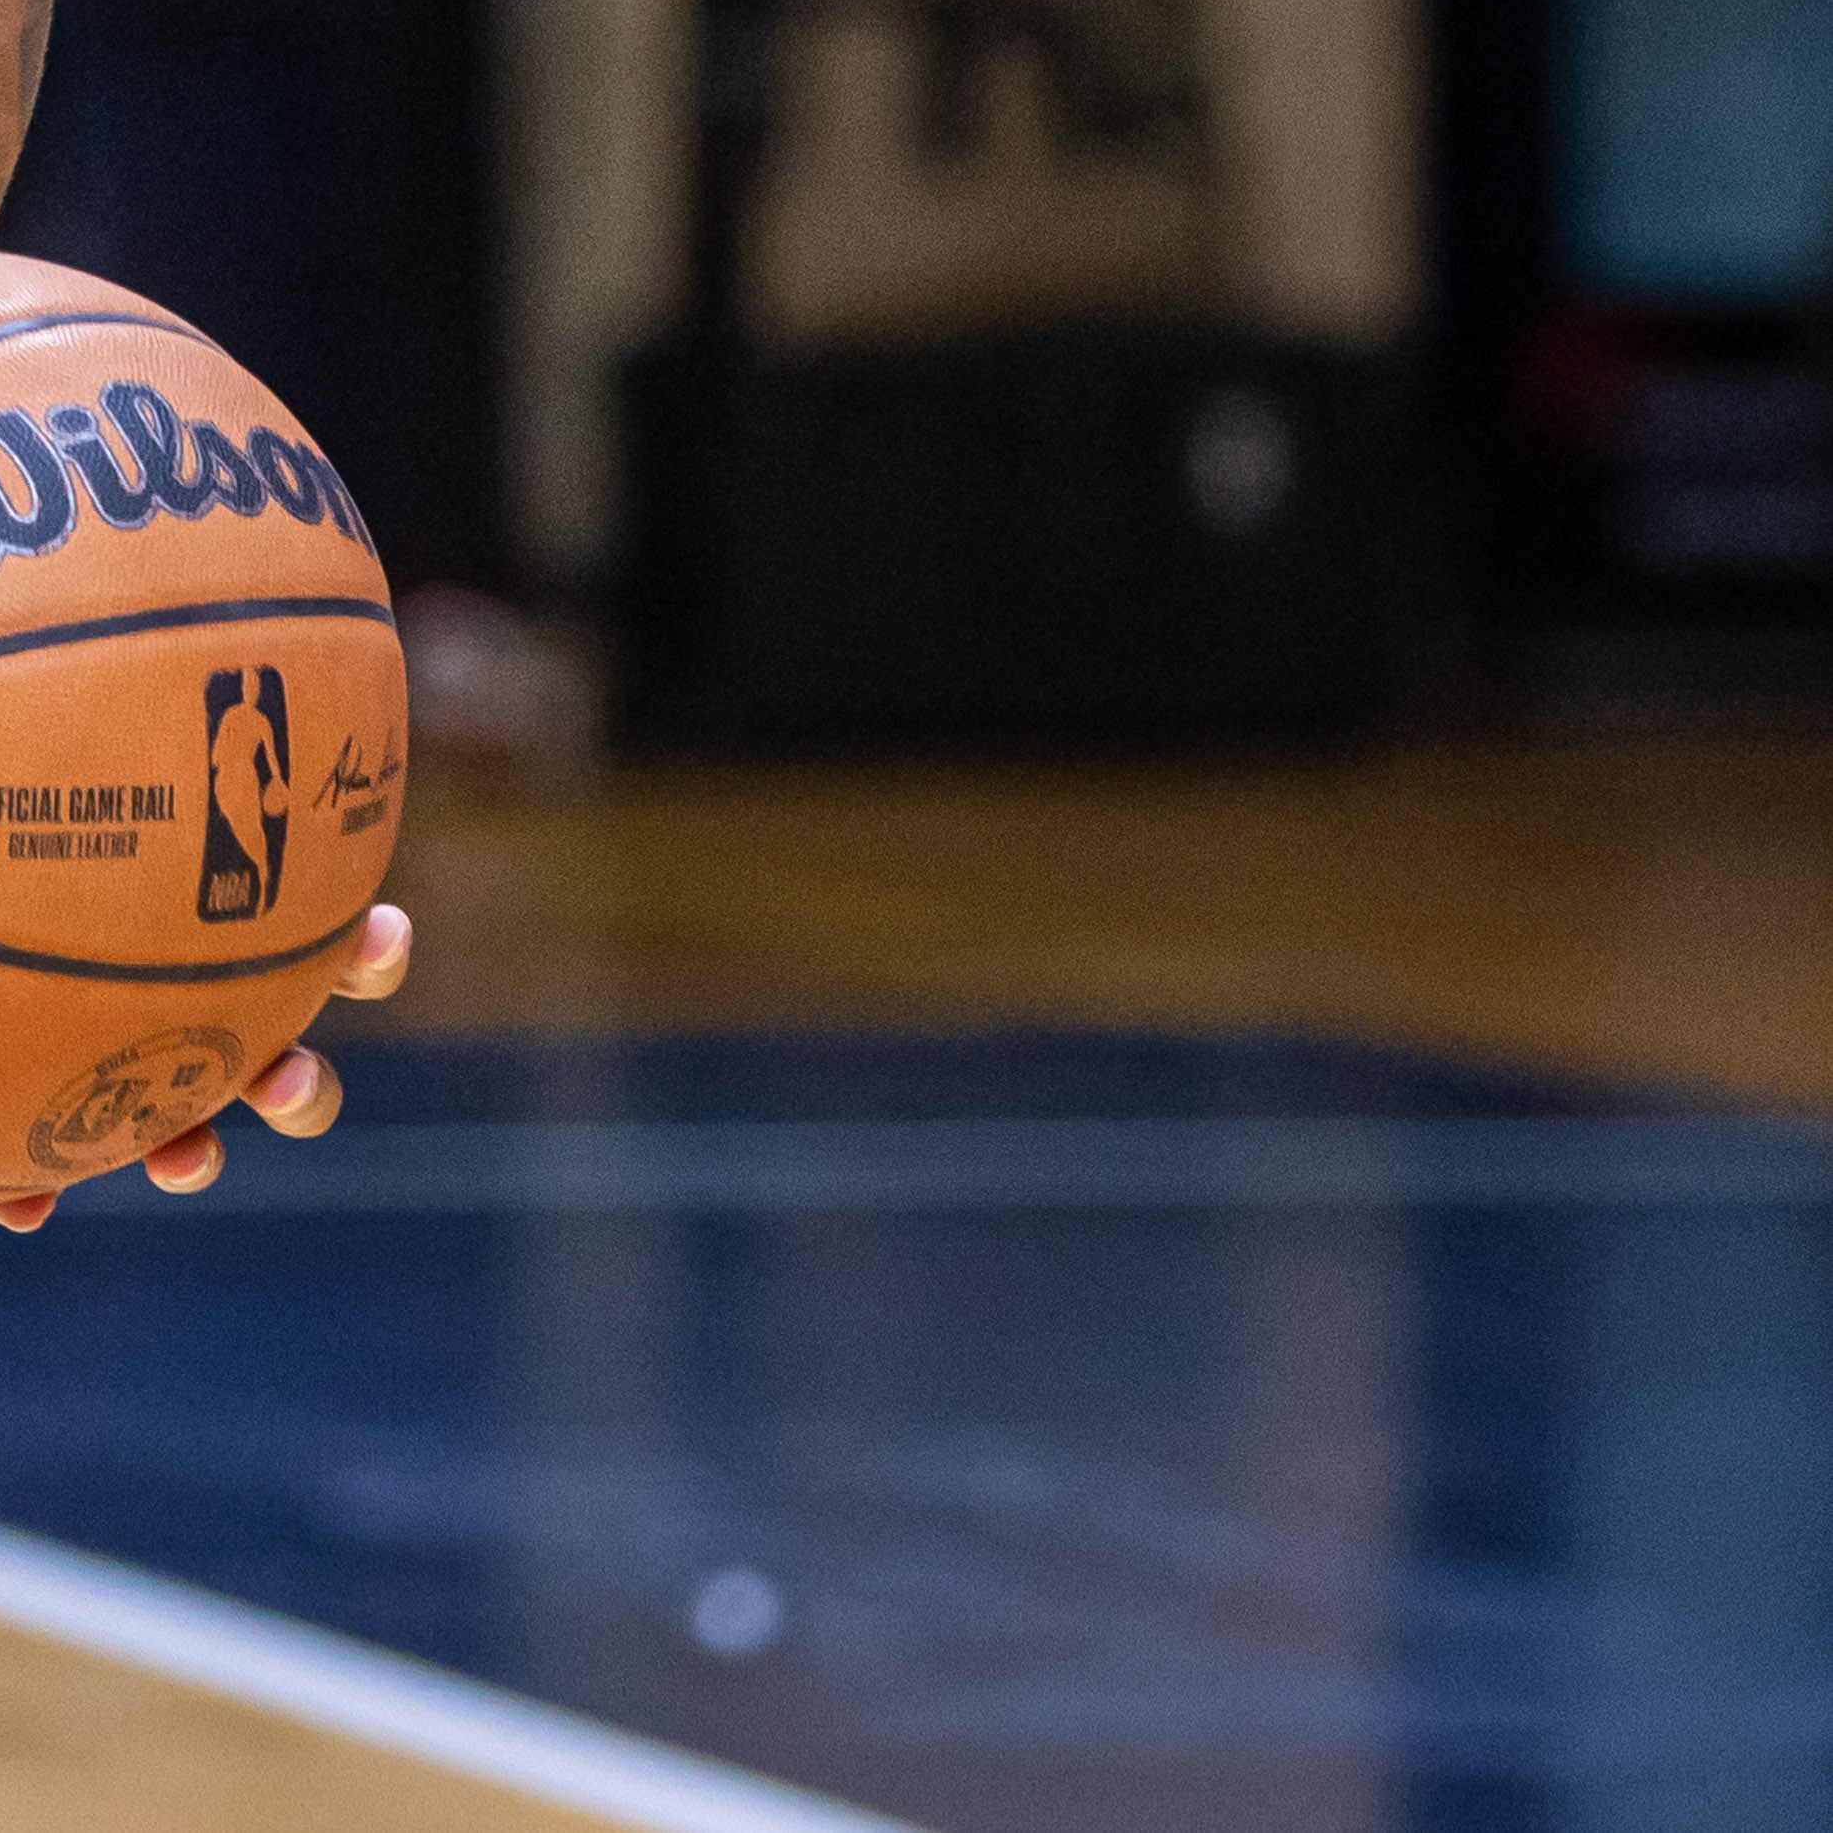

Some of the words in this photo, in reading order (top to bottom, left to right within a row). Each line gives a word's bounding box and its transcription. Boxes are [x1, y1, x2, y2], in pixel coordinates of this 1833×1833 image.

[68, 784, 124, 824] GAME
[130, 783, 176, 822] BALL
[7, 831, 73, 860] GENUINE
[77, 830, 139, 860] LEATHER
